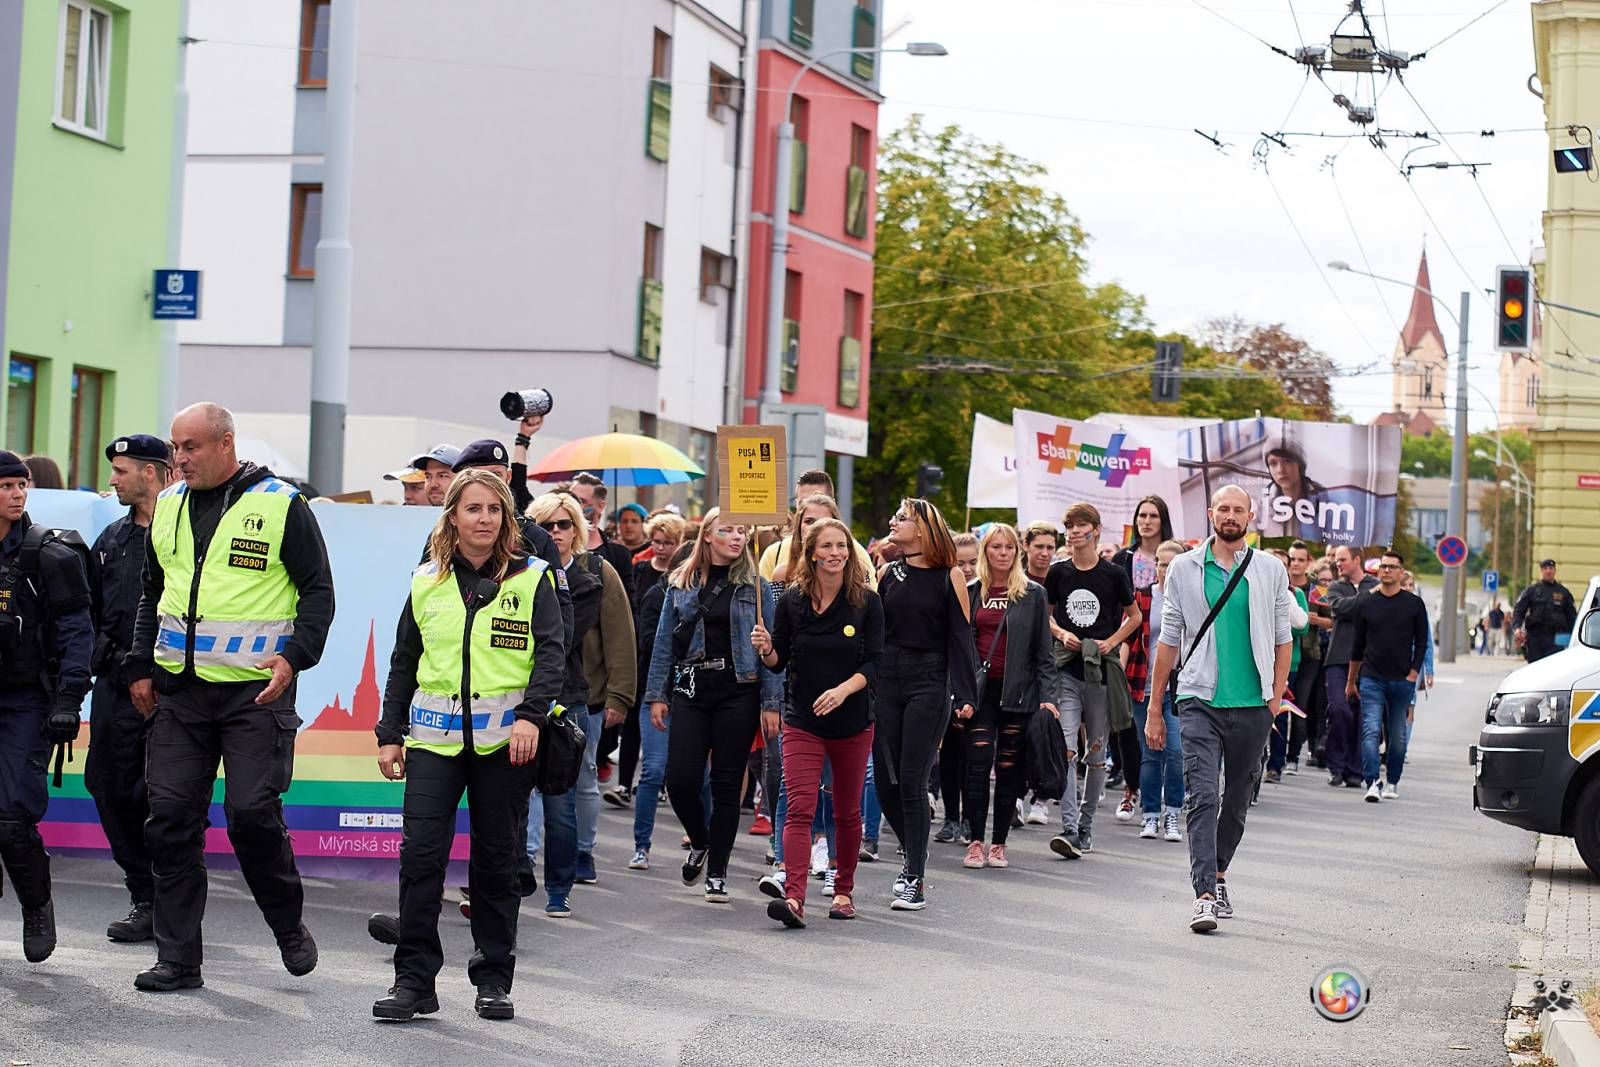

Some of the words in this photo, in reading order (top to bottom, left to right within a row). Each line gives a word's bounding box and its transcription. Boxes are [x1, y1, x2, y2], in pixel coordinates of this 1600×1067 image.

[738, 448, 756, 457] PUSA
[1041, 440, 1148, 470] sbarvouven.cz
[739, 472, 766, 480] DEPORTACE
[1333, 532, 1355, 543] holky
[232, 540, 268, 553] POLICIE
[232, 556, 264, 569] 226901
[1485, 574, 1495, 591] P
[982, 598, 1008, 610] VAN
[1072, 600, 1097, 611] HORSE
[493, 619, 528, 632] POLICIE
[494, 636, 525, 648] 302289
[413, 708, 443, 727] LICIE
[319, 835, 378, 855] Mlýnská
[382, 838, 402, 853] str
